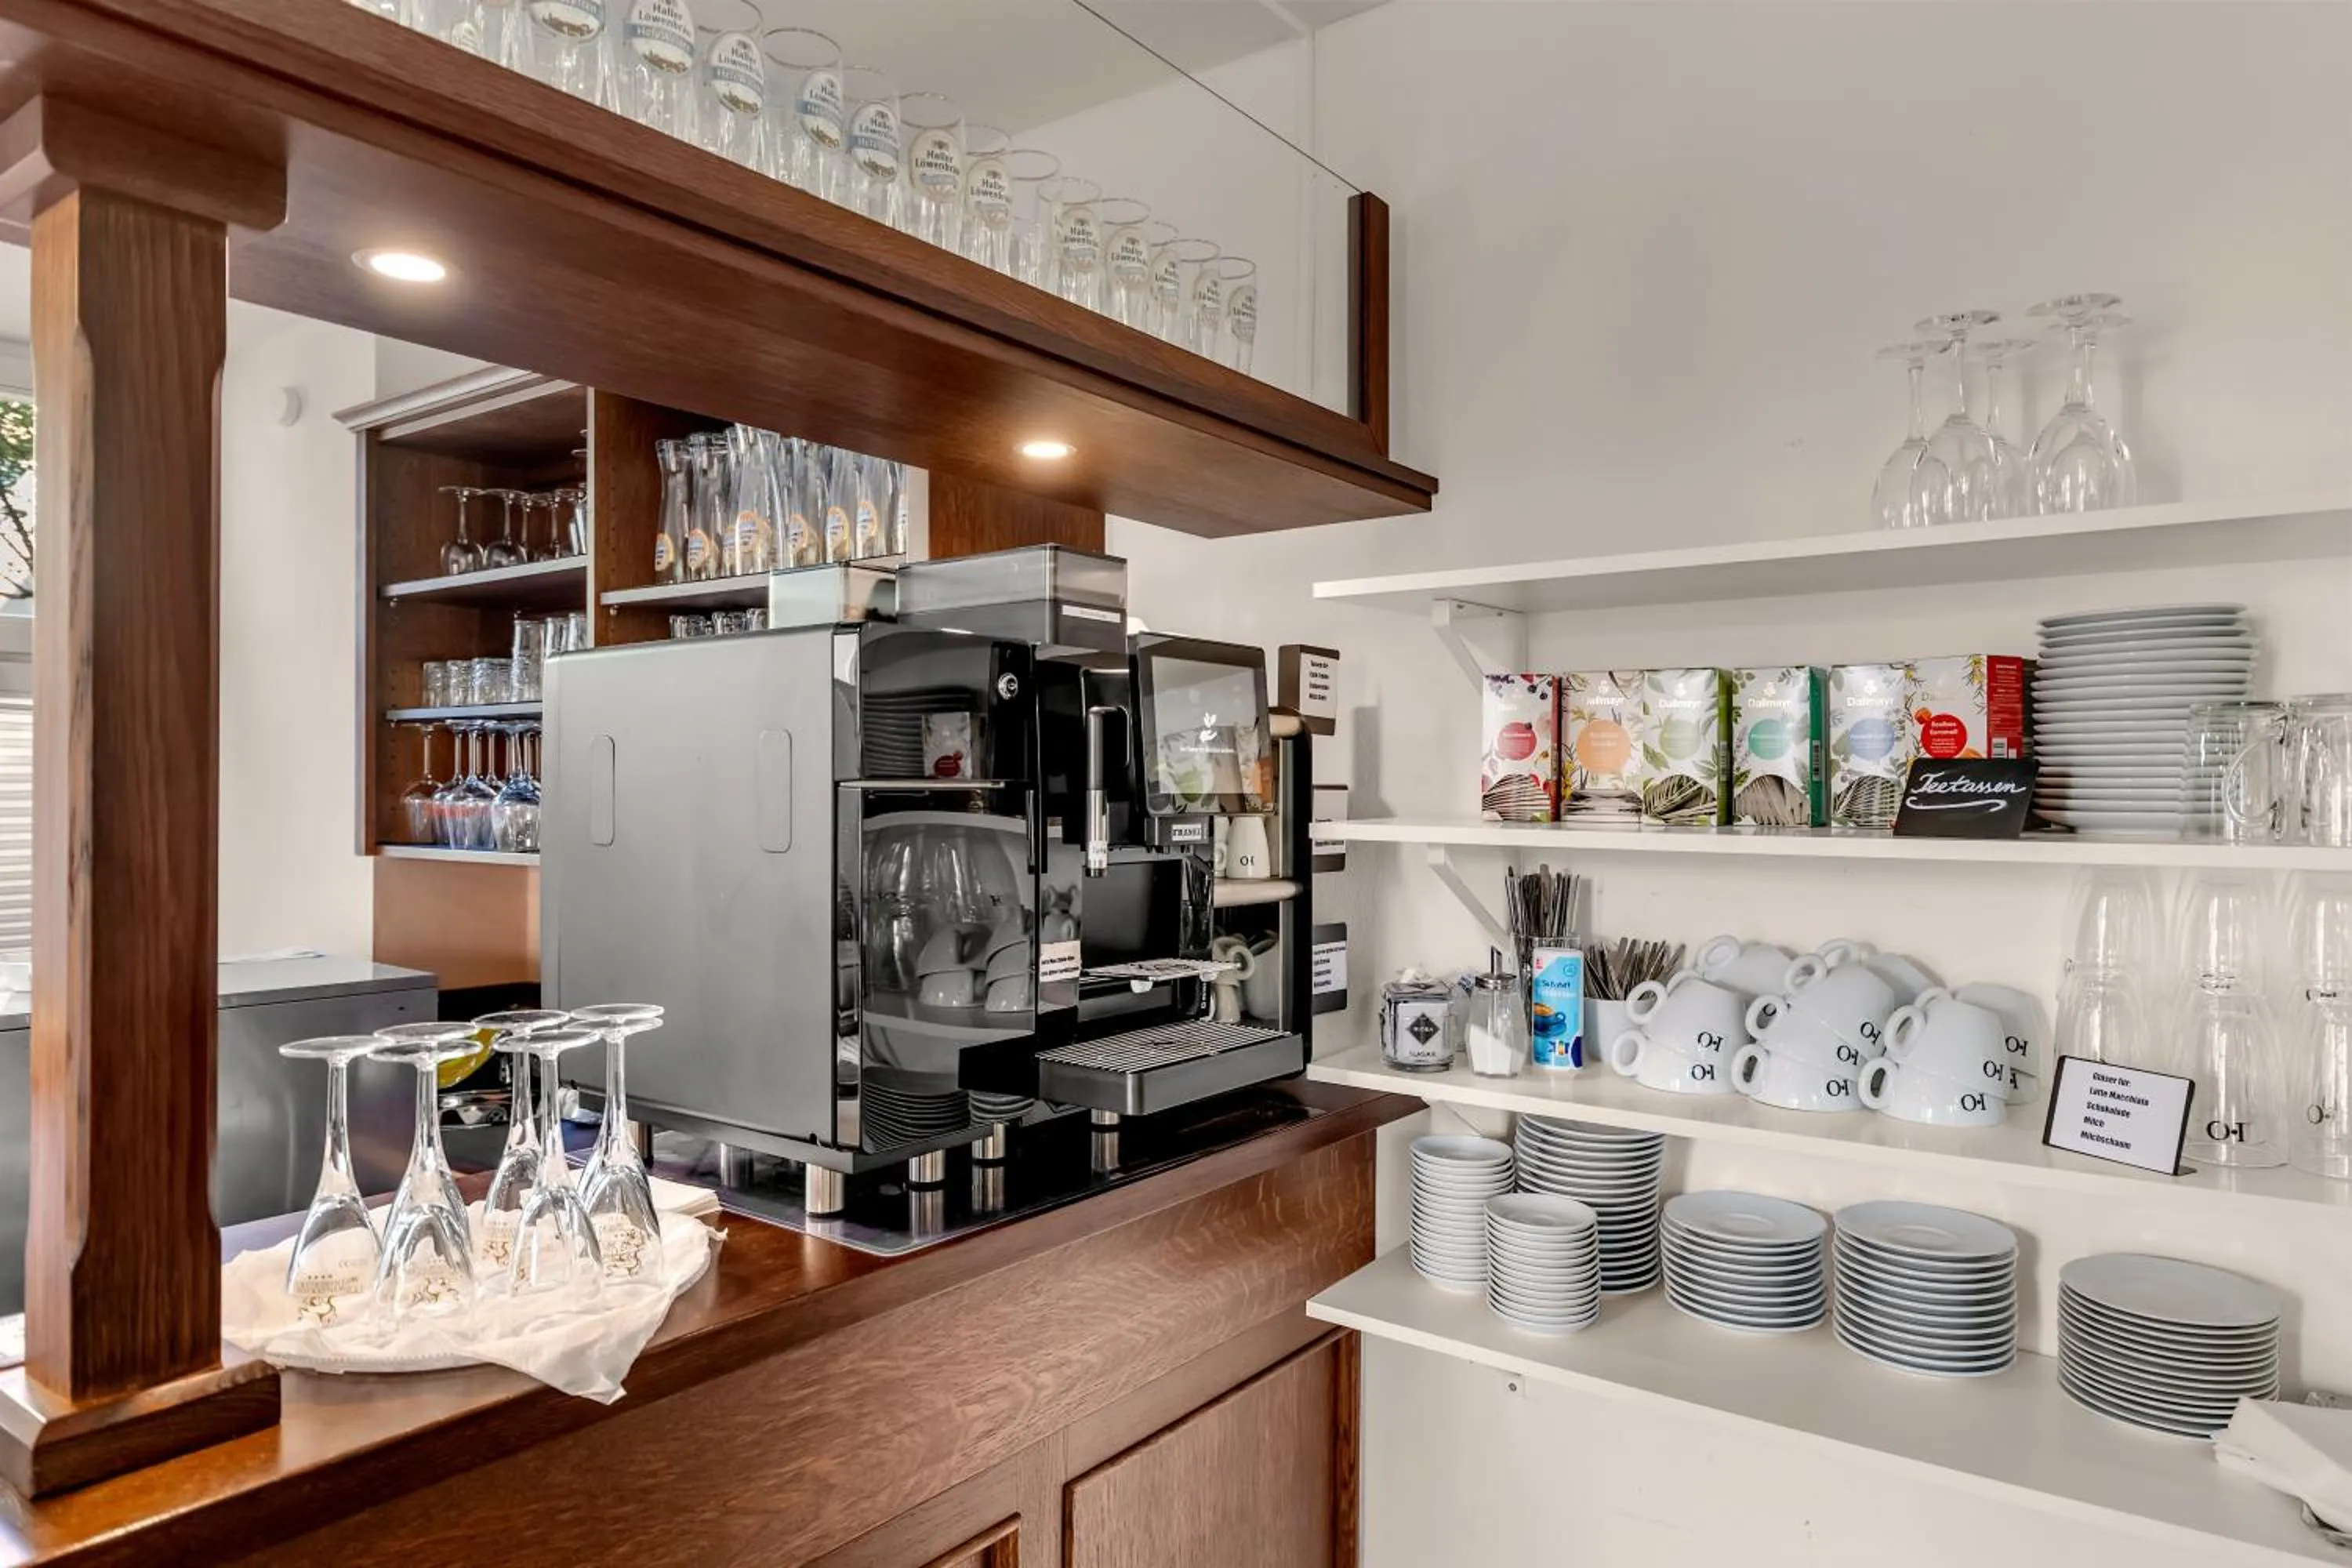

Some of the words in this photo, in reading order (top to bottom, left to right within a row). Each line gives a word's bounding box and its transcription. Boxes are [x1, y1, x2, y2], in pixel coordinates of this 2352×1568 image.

[1583, 696, 1625, 706] allmayr
[1911, 771, 2027, 794] Teetassen
[2083, 1116, 2105, 1128] Milch
